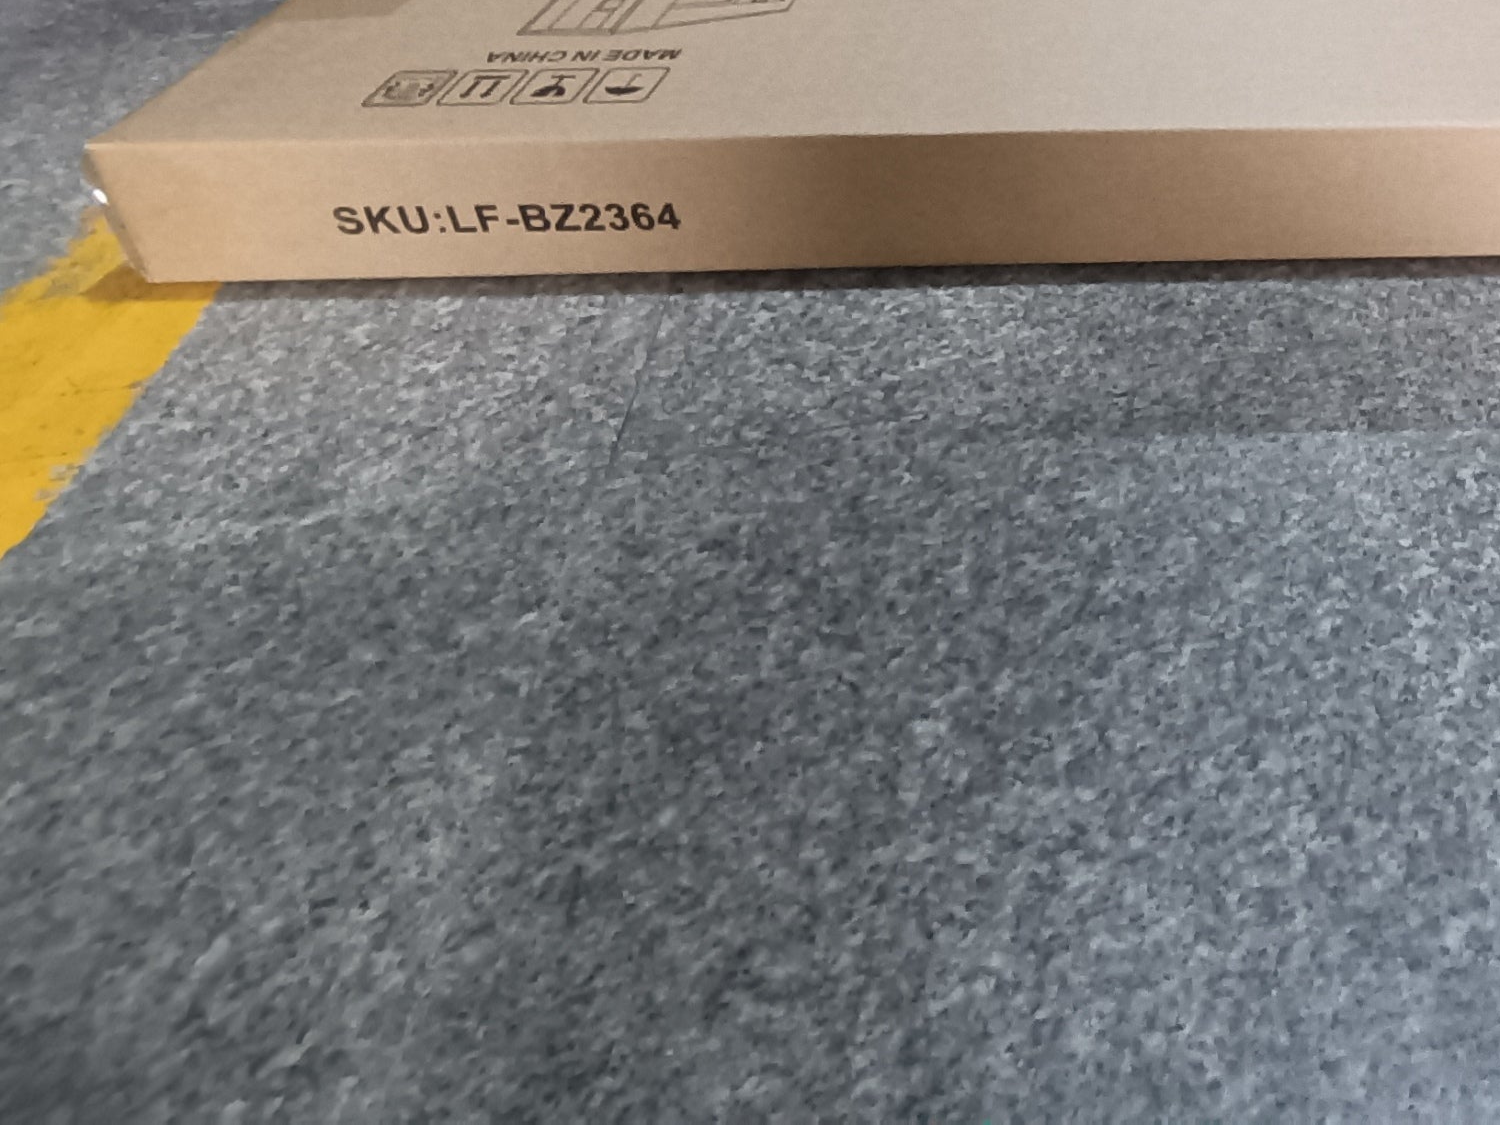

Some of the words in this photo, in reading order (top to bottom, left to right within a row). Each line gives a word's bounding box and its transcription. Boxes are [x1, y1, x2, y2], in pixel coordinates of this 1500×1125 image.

[486, 49, 568, 64] CHINA
[571, 49, 600, 63] IN
[605, 49, 682, 63] MADE
[332, 203, 682, 234] SKU:LF-BZ2364
